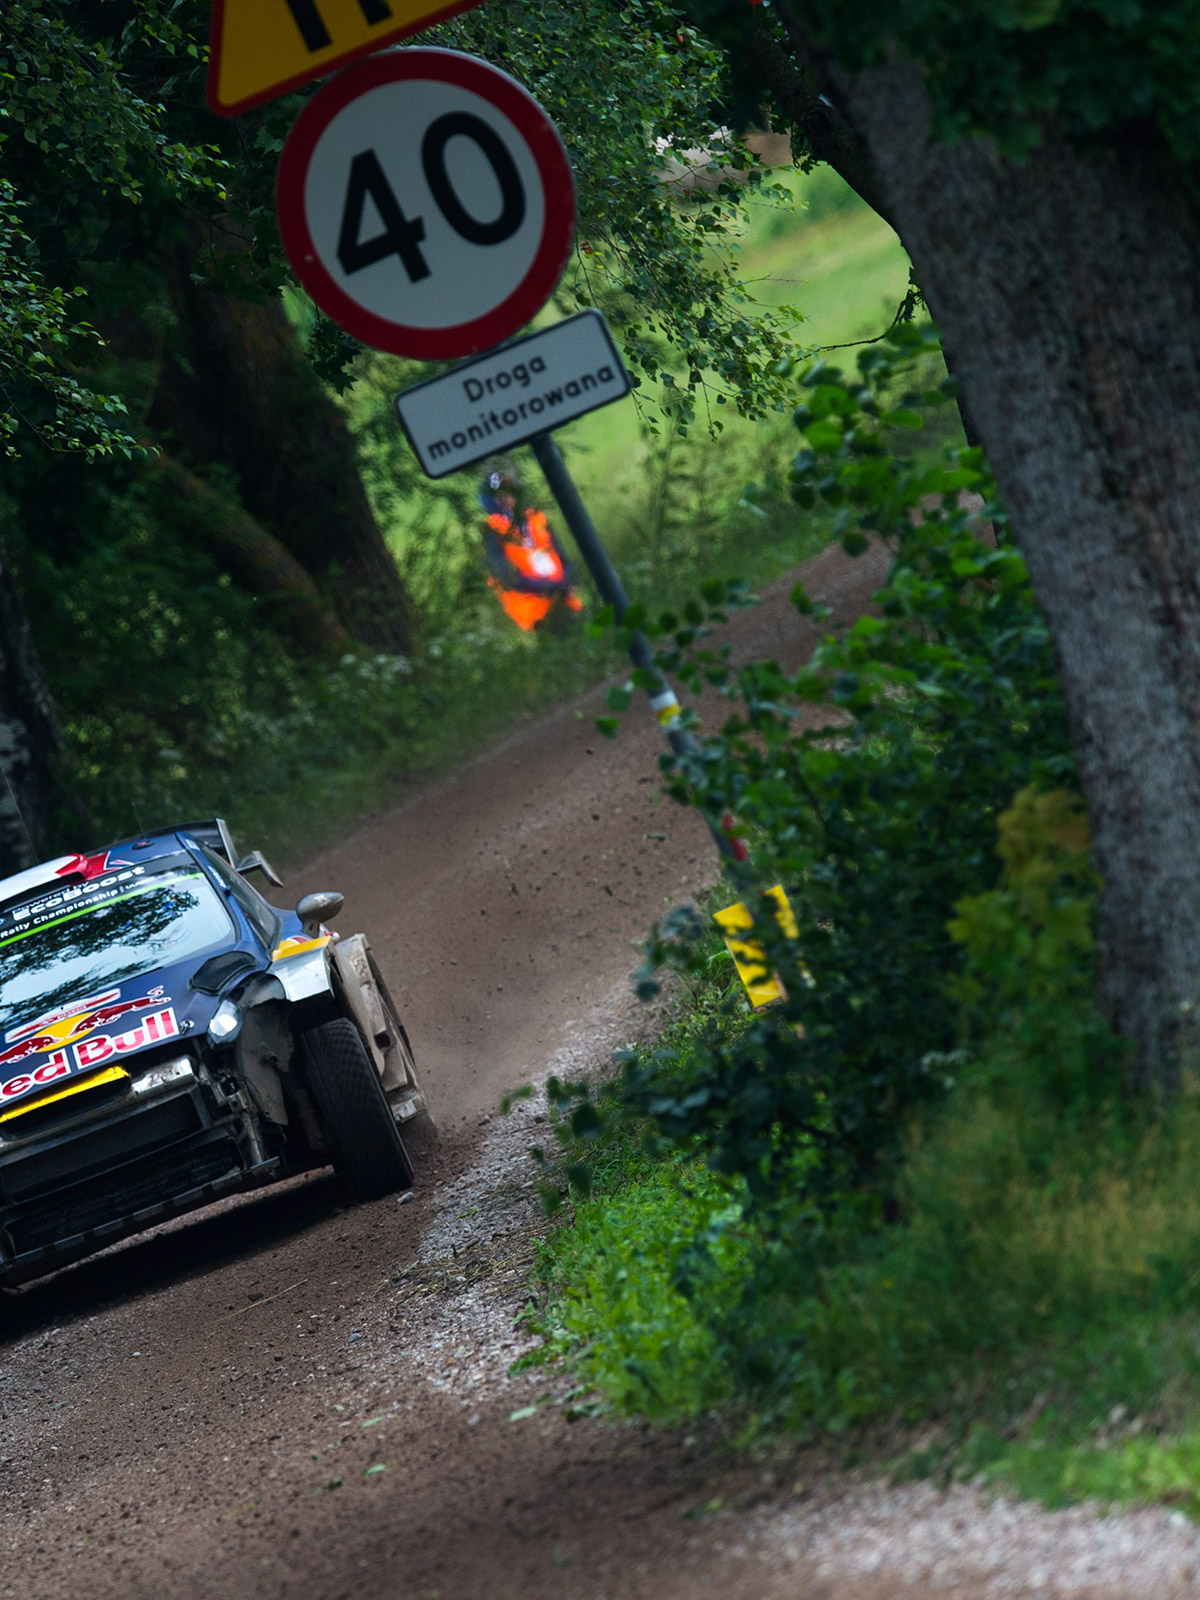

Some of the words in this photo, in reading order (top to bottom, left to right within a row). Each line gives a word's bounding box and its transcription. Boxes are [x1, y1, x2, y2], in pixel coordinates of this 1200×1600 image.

[337, 111, 526, 284] 40
[462, 355, 546, 402] Droga
[427, 365, 615, 460] monitorowana
[0, 922, 31, 939] Rally
[33, 887, 118, 925] Championship
[13, 866, 146, 921] EcoBoost
[74, 1009, 177, 1067] Bull
